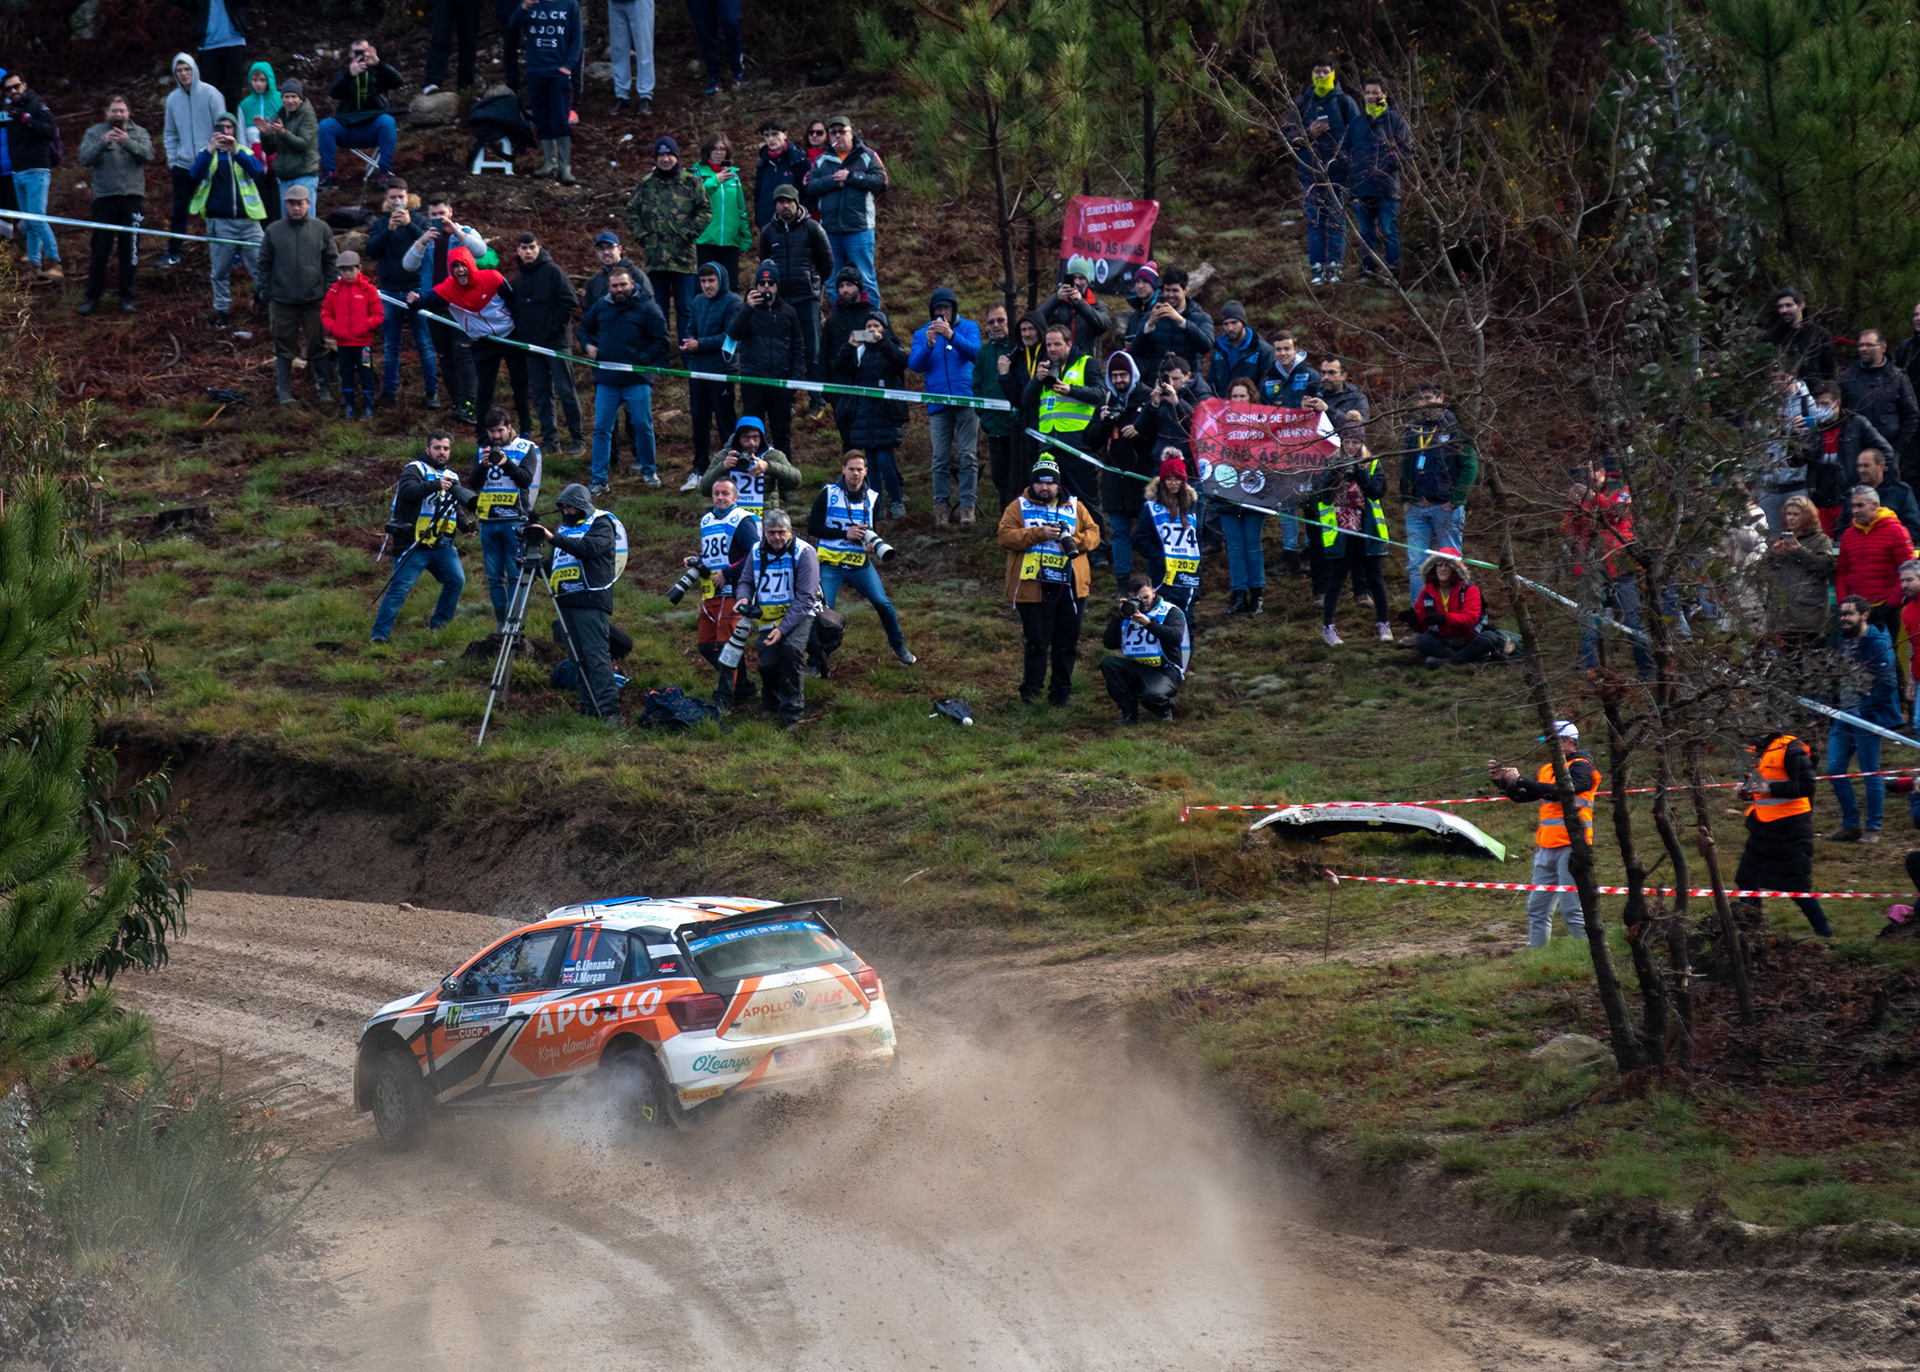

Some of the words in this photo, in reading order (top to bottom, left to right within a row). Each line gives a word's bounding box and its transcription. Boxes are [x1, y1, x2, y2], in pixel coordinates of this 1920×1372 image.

[492, 494, 513, 503] 2022
[1162, 525, 1197, 548] 274
[1043, 555, 1064, 567] 2022
[571, 923, 602, 961] 17
[725, 931, 742, 941] ERC
[742, 928, 758, 938] LIVE
[759, 926, 770, 935] ON
[813, 934, 839, 952] 17
[573, 972, 606, 984] J.Morgan
[447, 1006, 462, 1028] 17
[536, 986, 663, 1039] APOLLO
[743, 1000, 792, 1019] APOLLO
[692, 1054, 750, 1075] O'Learys
